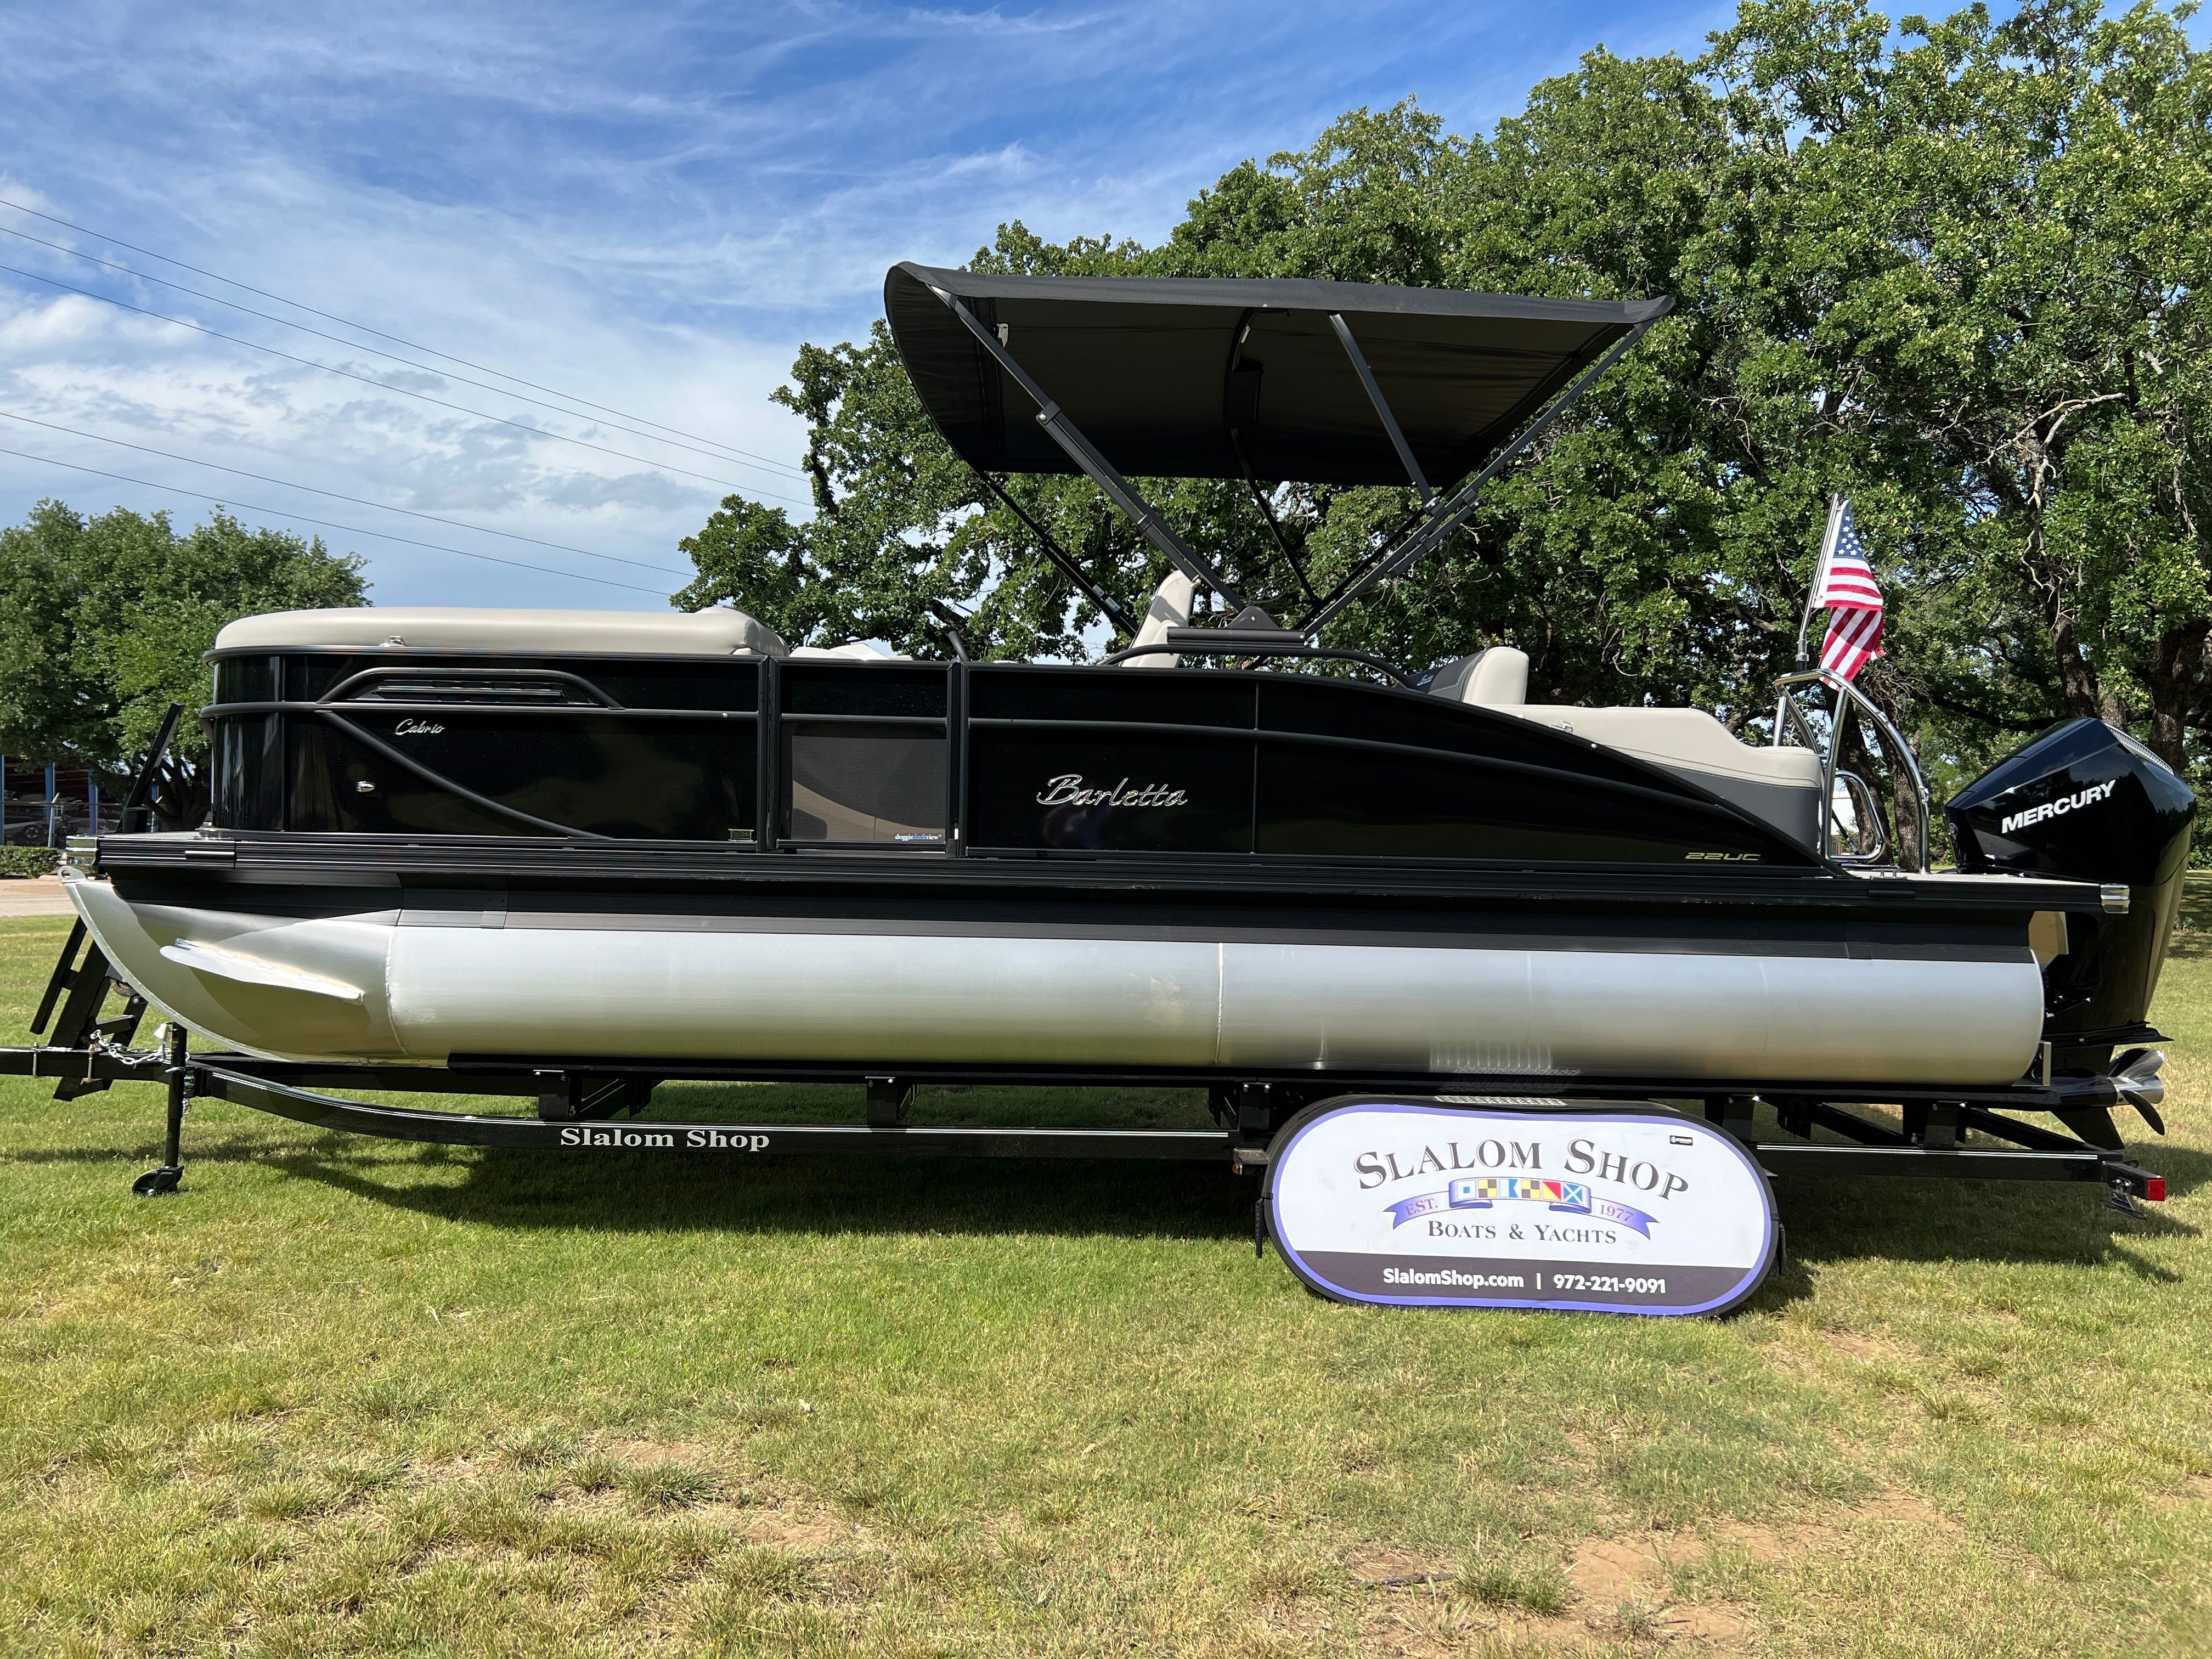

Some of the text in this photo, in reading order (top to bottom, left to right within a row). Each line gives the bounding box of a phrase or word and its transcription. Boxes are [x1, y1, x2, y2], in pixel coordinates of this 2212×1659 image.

[394, 719, 445, 735] Cabrio
[1036, 774, 1188, 806] Barletta
[2002, 779, 2116, 834] MERCURY
[1685, 852, 1761, 861] 22UC
[560, 1128, 770, 1152] Slalom Shop
[1353, 1138, 1689, 1201] SLALOM SHOP
[1404, 1198, 1438, 1216] EST.
[1600, 1204, 1634, 1222] 1977
[1428, 1220, 1617, 1244] BOATS & YACHTS
[1383, 1268, 1525, 1289] SlalomShop.com
[1553, 1274, 1666, 1294] 972-221-9091
